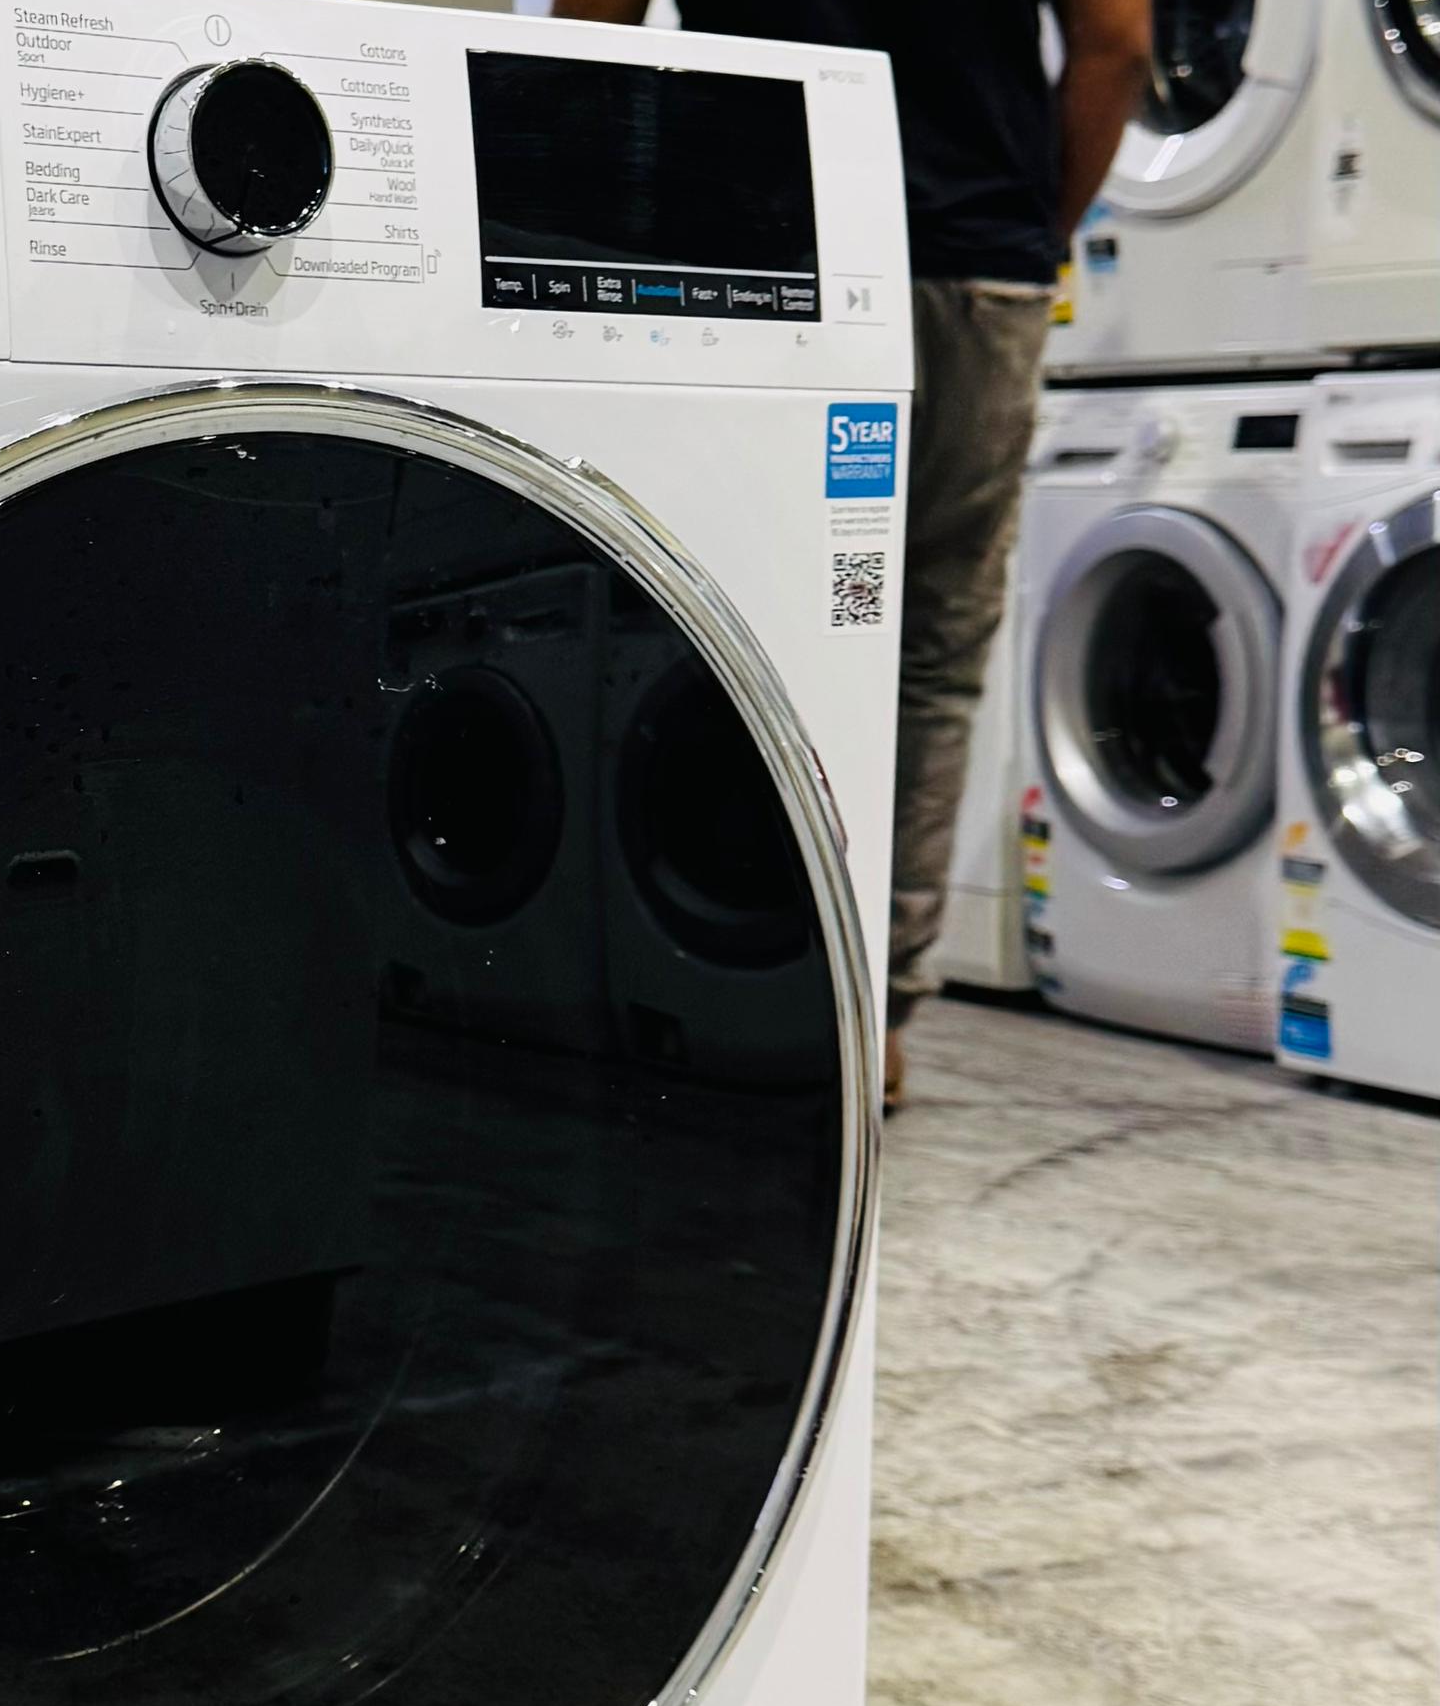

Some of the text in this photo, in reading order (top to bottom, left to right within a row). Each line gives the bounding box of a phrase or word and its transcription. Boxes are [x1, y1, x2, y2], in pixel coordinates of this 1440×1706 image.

[14, 8, 113, 31] Steam Refresh
[16, 32, 72, 51] Outdoor
[17, 50, 45, 63] Sport
[360, 43, 406, 61] Cottons
[20, 82, 84, 102] Hygiene+
[341, 78, 410, 97] Cottons Eco
[350, 112, 412, 130] Synthetics
[23, 123, 101, 143] StainExpert
[26, 161, 80, 182] Bedding
[387, 177, 416, 192] Wool
[26, 187, 90, 205] Dark Care
[385, 225, 420, 240] Shirts
[30, 240, 67, 256] Rinse
[294, 257, 420, 279] Downloaded Program
[548, 280, 571, 294] Spin
[200, 299, 269, 317] Spin+Drain
[831, 415, 893, 453] 5 YEAR
